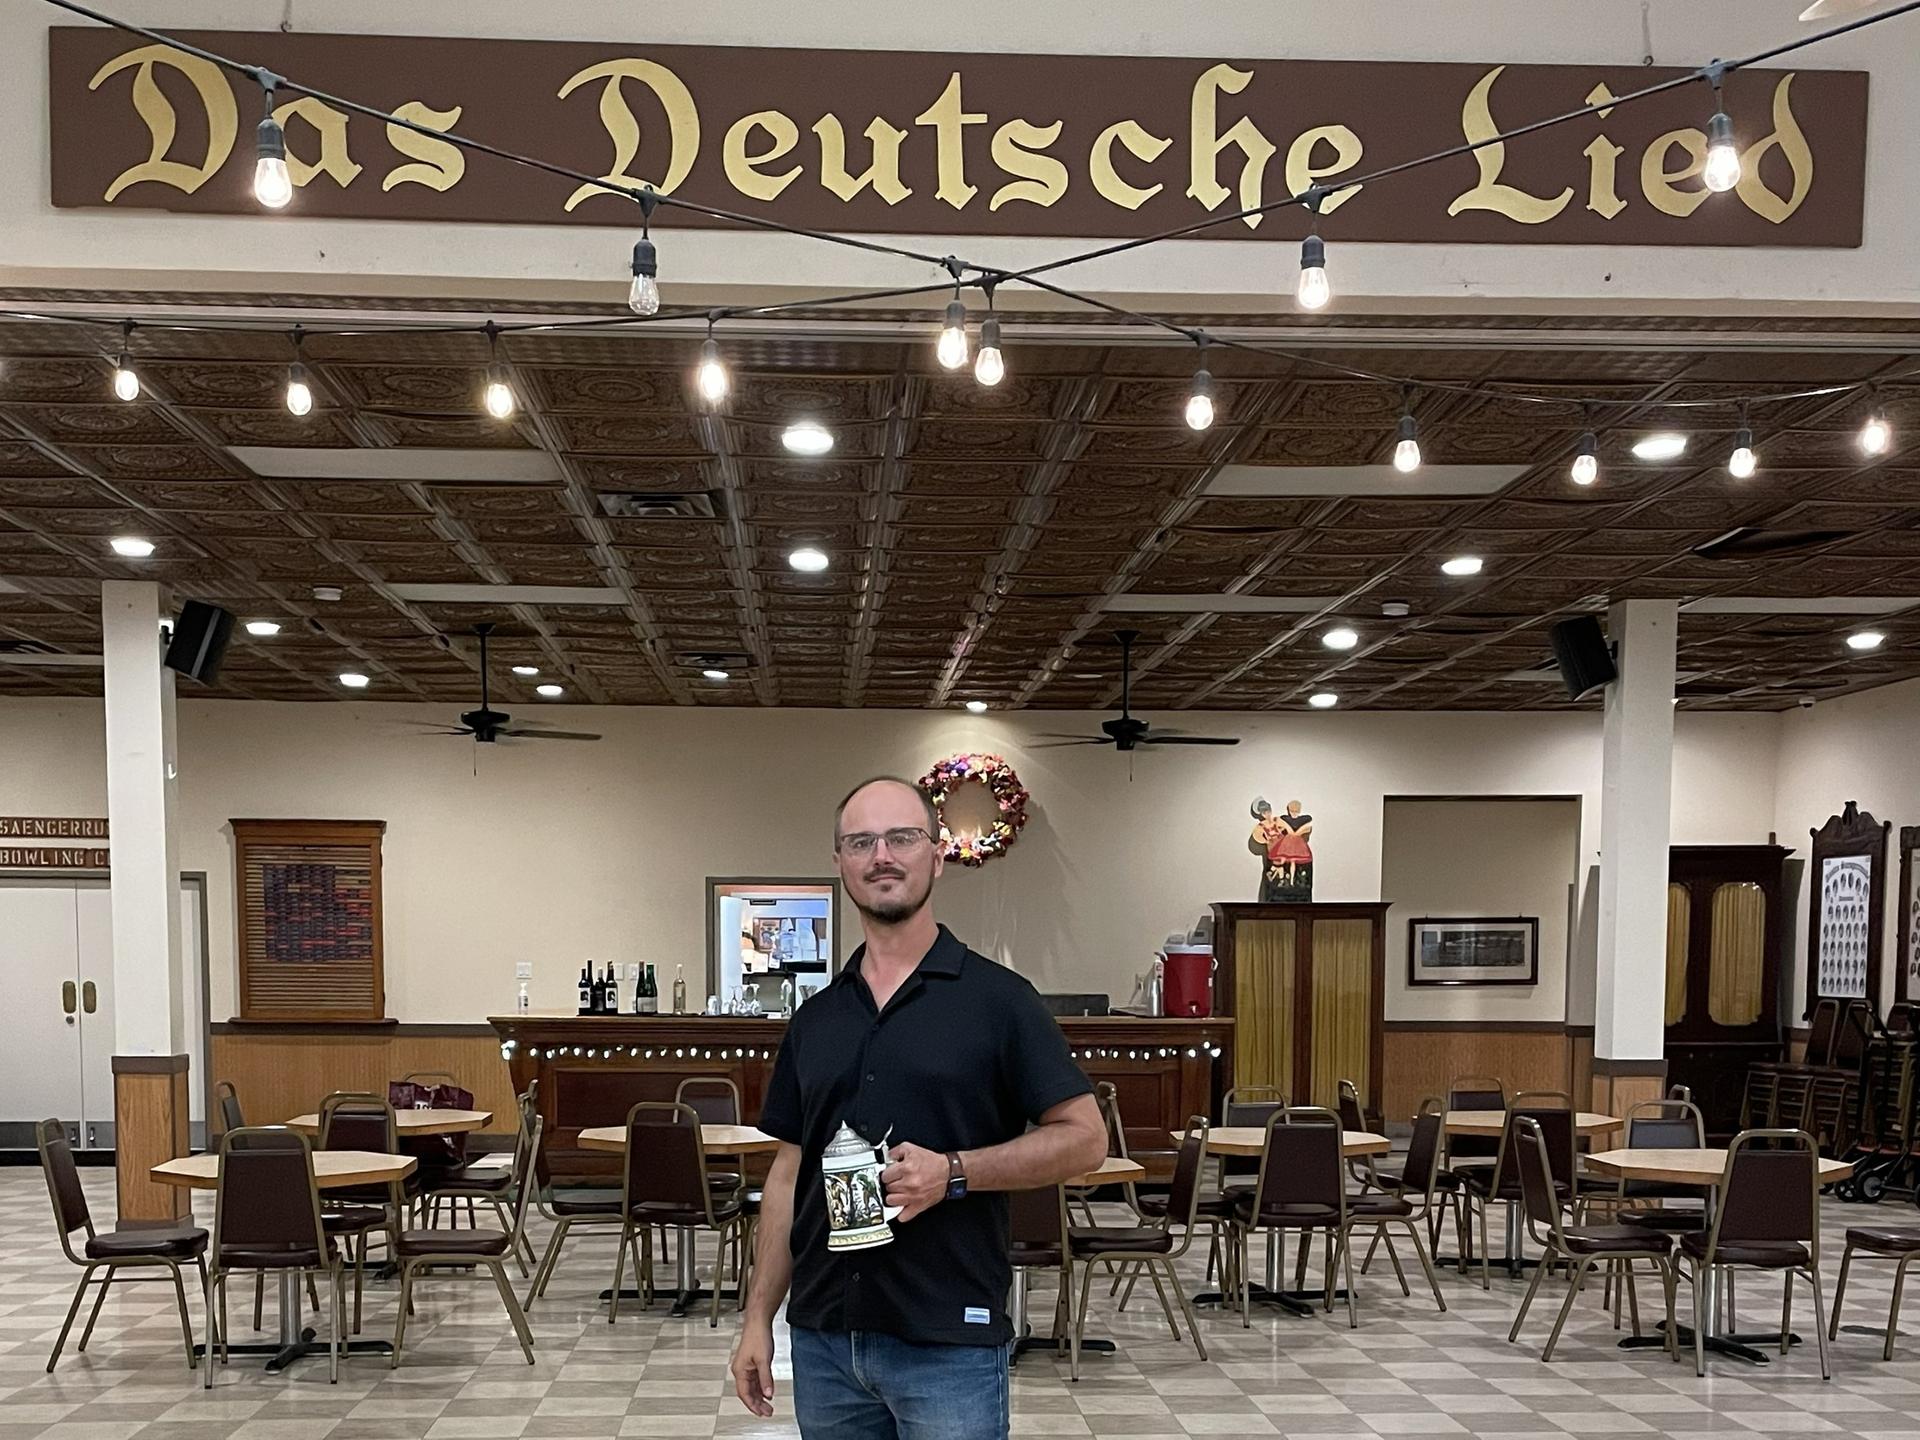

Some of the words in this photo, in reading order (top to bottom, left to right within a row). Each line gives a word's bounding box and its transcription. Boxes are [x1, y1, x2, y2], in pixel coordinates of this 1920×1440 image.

[89, 44, 466, 202] Das
[557, 58, 1364, 230] Deutsche
[1448, 65, 1815, 224] Lied
[0, 820, 109, 835] SAENGERRU
[0, 850, 84, 865] BOWLING
